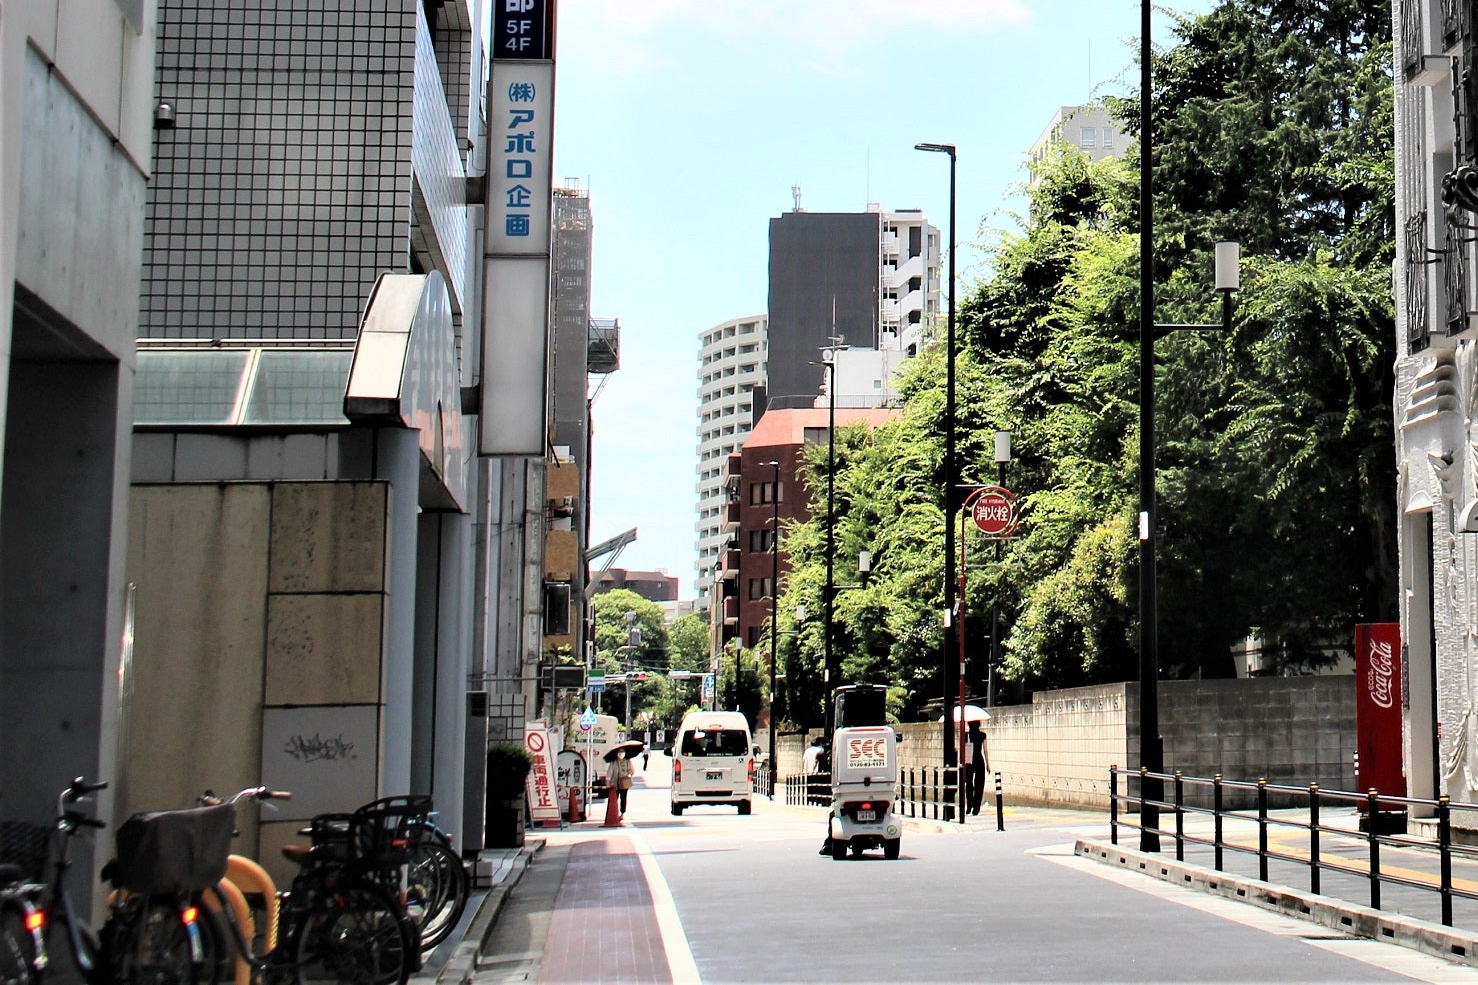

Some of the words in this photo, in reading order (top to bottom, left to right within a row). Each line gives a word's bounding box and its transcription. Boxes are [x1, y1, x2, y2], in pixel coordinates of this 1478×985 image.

[506, 19, 531, 34] 5F
[505, 37, 530, 52] 4F
[504, 82, 536, 237] (株)アポロ企画
[976, 505, 1009, 521] 消火栓
[850, 739, 884, 758] SEC
[532, 755, 552, 807] 車両通行止
